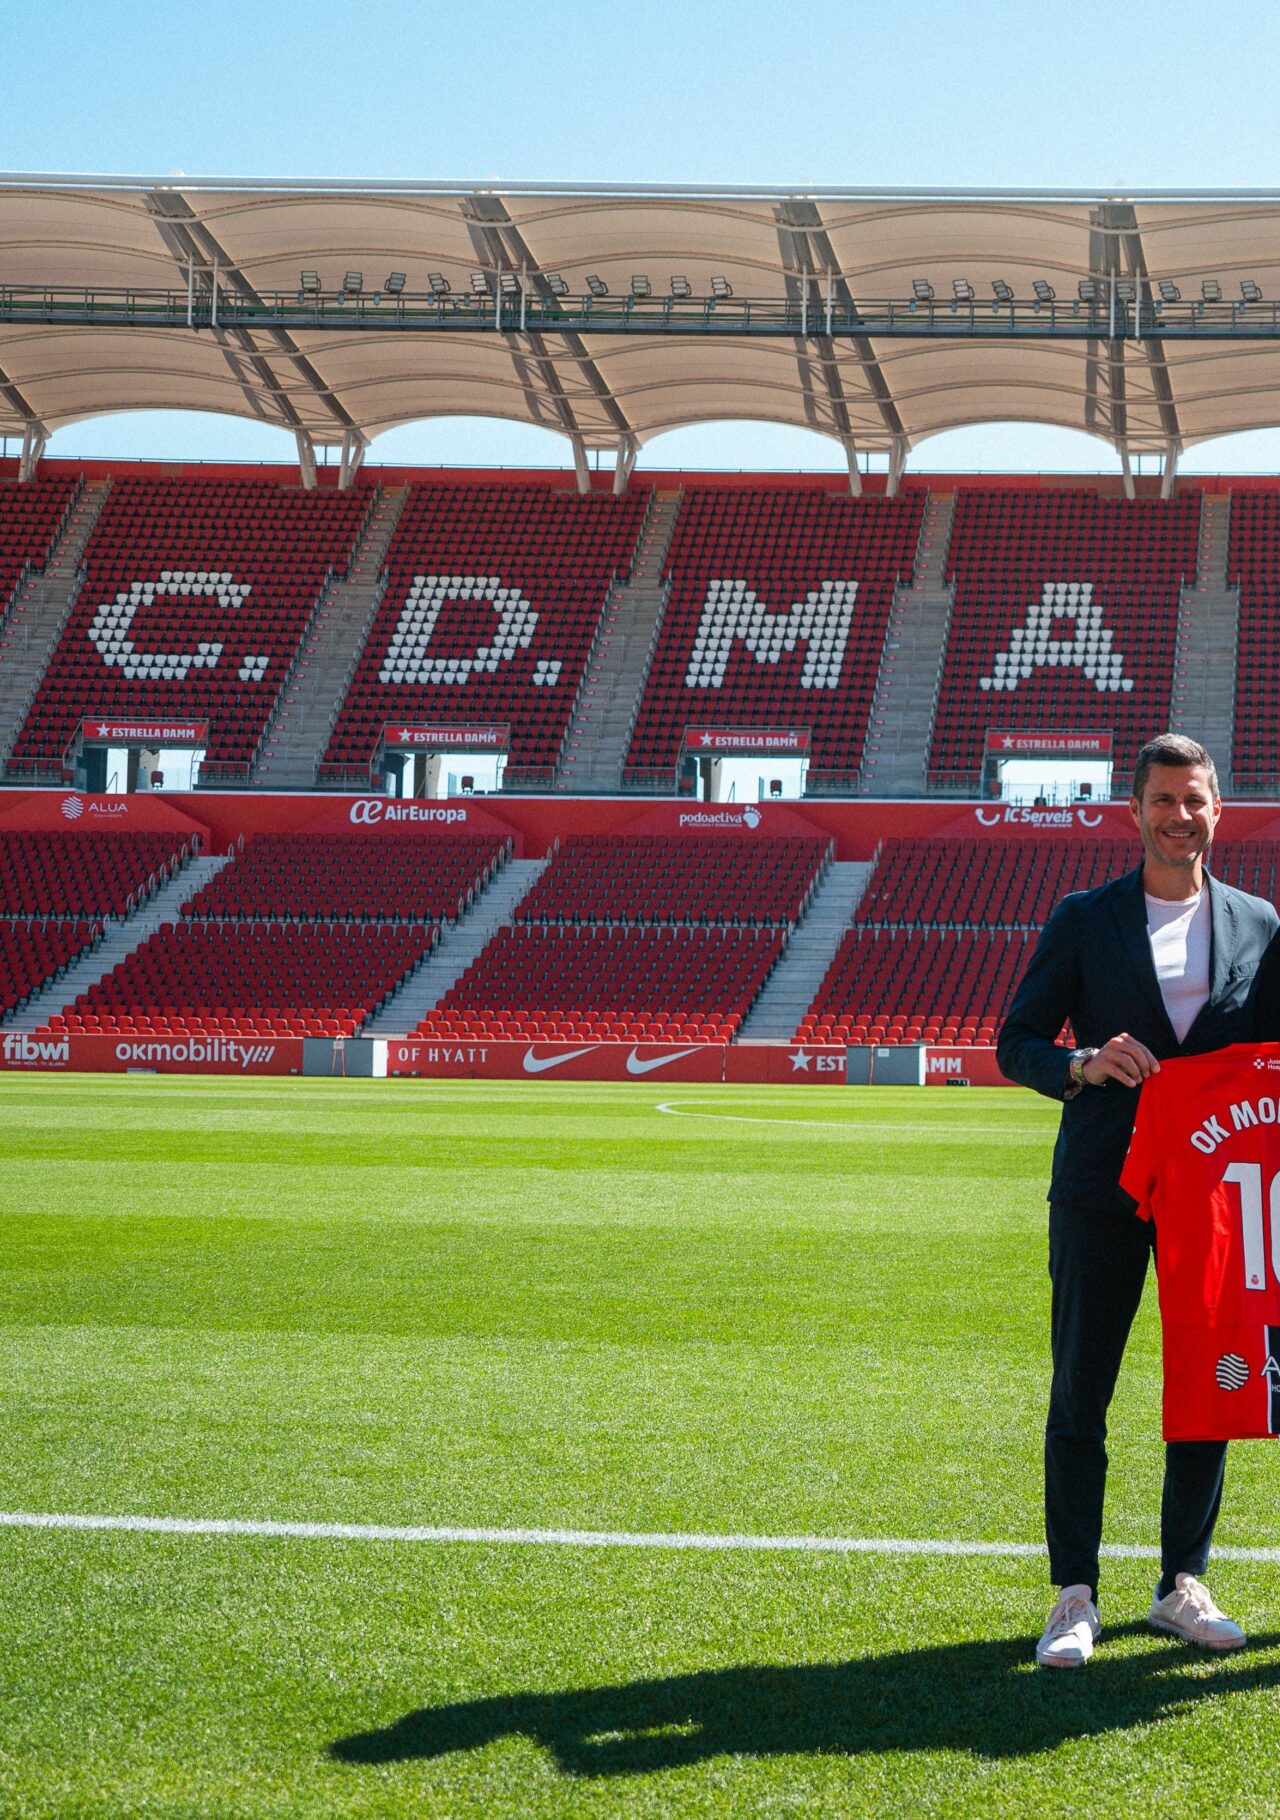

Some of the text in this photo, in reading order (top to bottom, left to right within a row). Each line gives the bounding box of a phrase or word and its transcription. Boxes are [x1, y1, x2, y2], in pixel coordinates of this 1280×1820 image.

[112, 727, 195, 738] ESTRELLA DAMM
[414, 733, 497, 743] ESTRELLA DAMM
[715, 737, 798, 747] ESTRELLA DAMM
[1016, 740, 1100, 750] ESTRELLA DAMM
[88, 802, 128, 812] ALUA
[680, 812, 742, 827] podoactiva
[3, 1034, 69, 1060] fibwi
[398, 1047, 488, 1062] OF HYATT
[1190, 1114, 1231, 1155] OK
